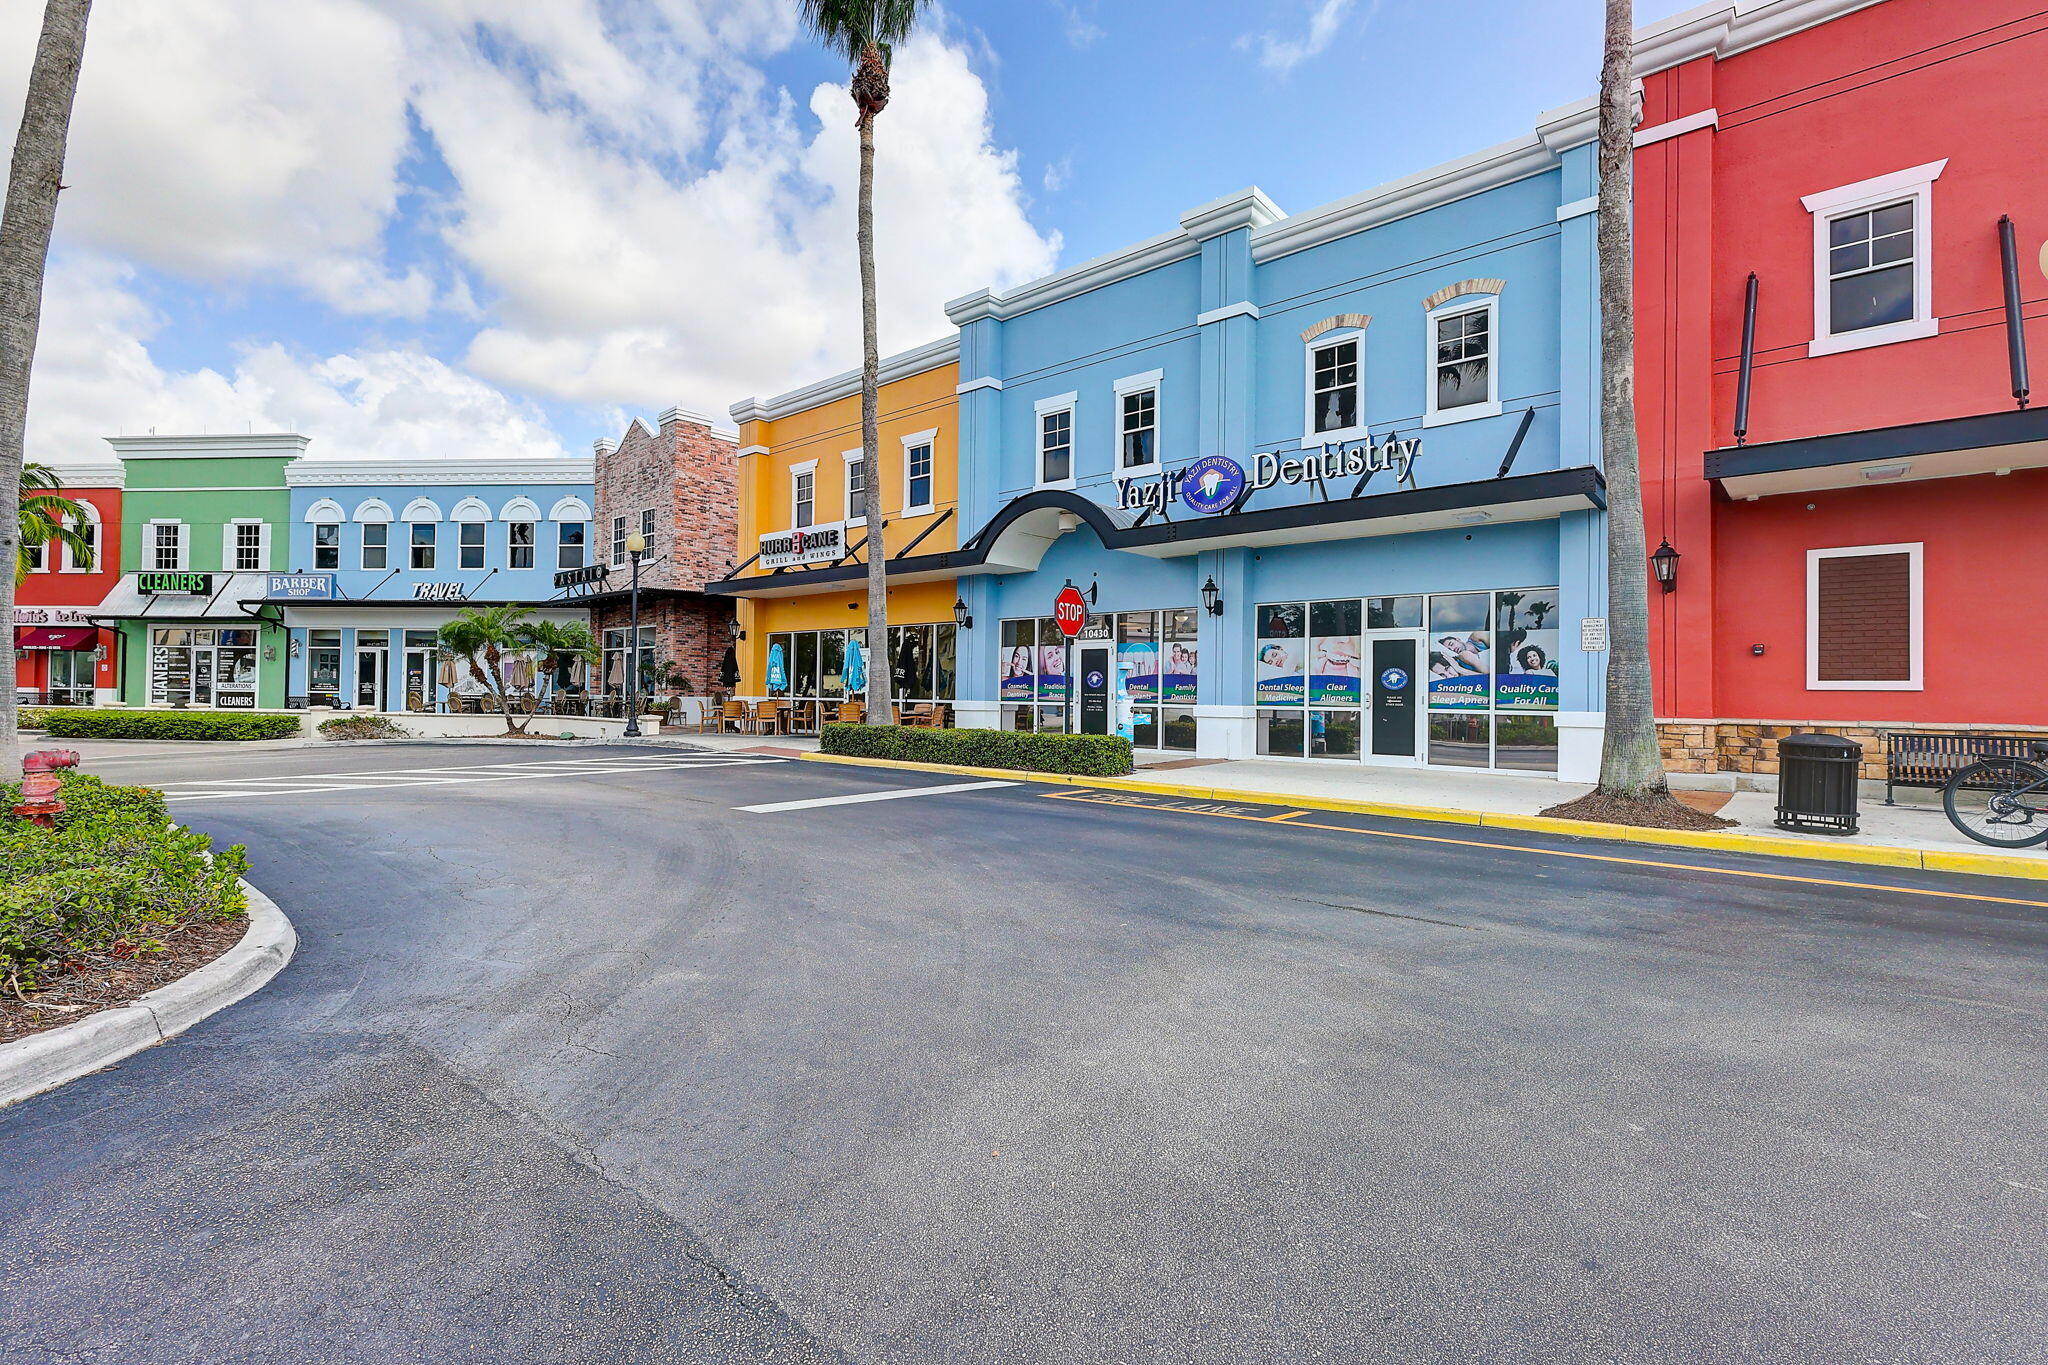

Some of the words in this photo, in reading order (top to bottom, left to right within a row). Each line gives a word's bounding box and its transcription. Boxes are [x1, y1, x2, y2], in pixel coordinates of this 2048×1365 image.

[1251, 434, 1421, 489] Dentistry
[1184, 464, 1201, 483] YAZJI
[1201, 457, 1240, 476] DENTISTRY
[1112, 470, 1178, 515] Yazji
[1185, 491, 1205, 508] QUALITY
[765, 556, 789, 565] GRILL
[809, 549, 837, 559] WINGS
[139, 573, 205, 591] CLEANERS
[272, 577, 327, 592] BARBER
[287, 588, 311, 596] SHOP
[411, 582, 465, 598] TRAVEL
[1057, 602, 1083, 622] STOP
[1083, 629, 1109, 639] 10430
[152, 647, 169, 703] LEANERS
[1129, 683, 1149, 691] Dental
[1175, 683, 1197, 693] Family
[1259, 683, 1283, 691] Dental
[1284, 683, 1305, 693] Sleep
[1326, 683, 1347, 691] Clear
[1436, 683, 1474, 694] Snoring
[1474, 683, 1483, 693] &
[1500, 684, 1537, 694] Quality
[1006, 691, 1029, 699] Dentistry
[1171, 693, 1197, 701] Dentistr
[1264, 694, 1298, 702] Medicine
[1320, 694, 1353, 703] Aligners
[219, 696, 253, 706] CLEANERS
[1431, 695, 1457, 705] Sleep
[1457, 695, 1489, 706] Apnea
[1513, 696, 1529, 705] For
[1531, 696, 1547, 705] All
[1157, 801, 1262, 815] LANE
